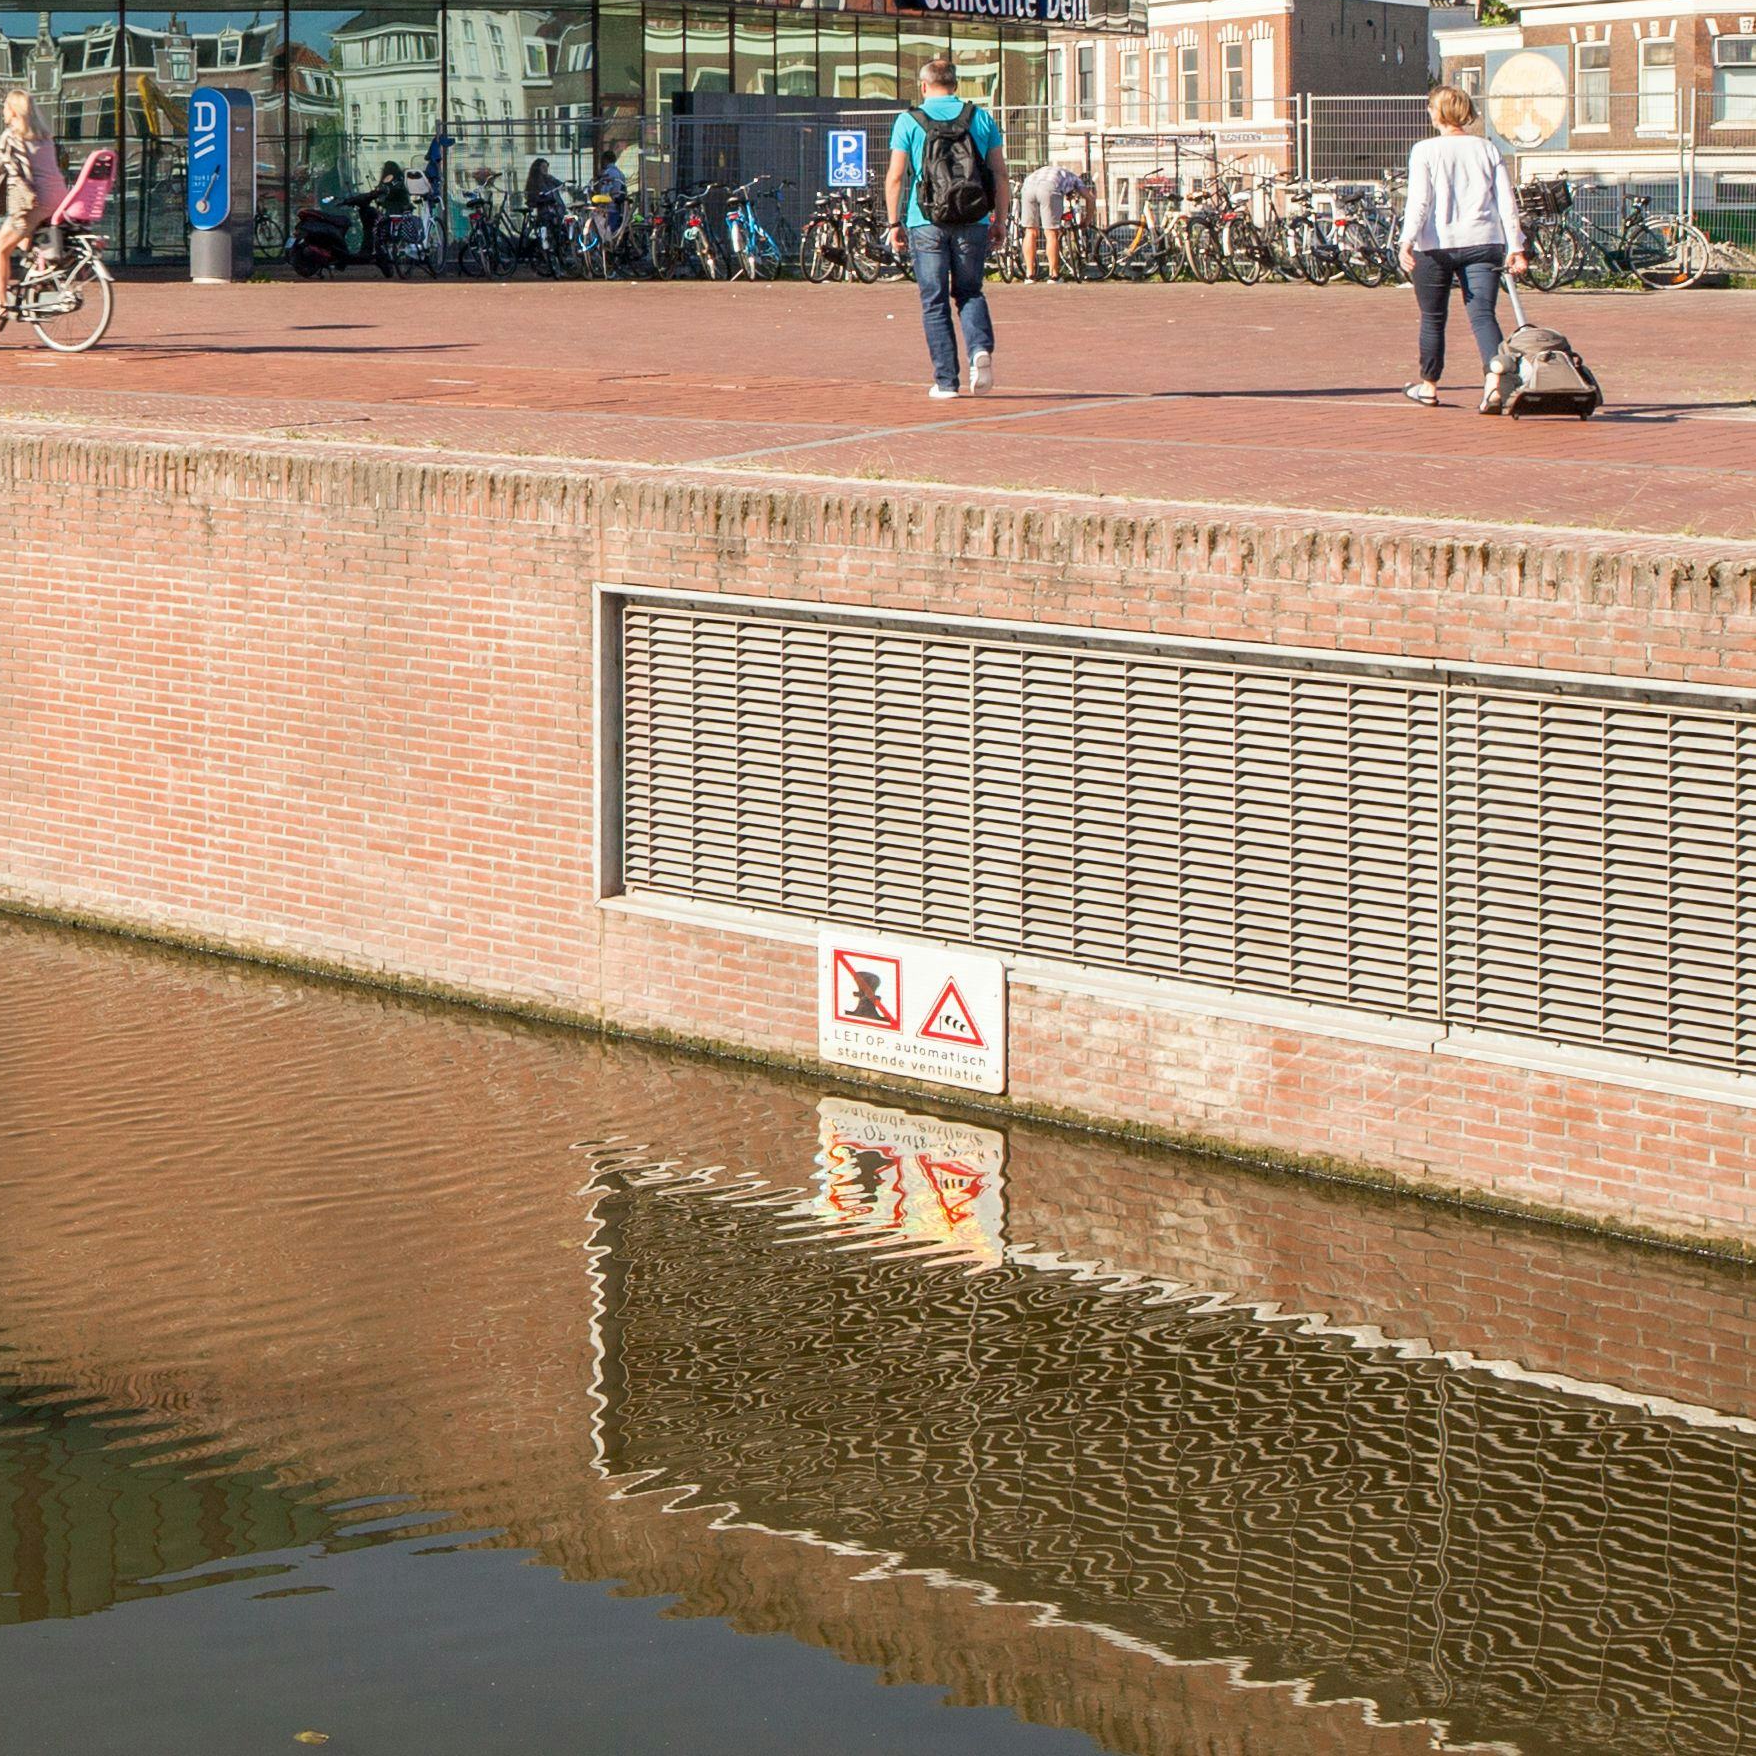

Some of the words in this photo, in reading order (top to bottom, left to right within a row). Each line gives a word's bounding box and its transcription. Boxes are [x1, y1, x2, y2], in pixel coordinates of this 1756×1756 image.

[837, 135, 858, 163] P
[834, 1028, 859, 1043] LET
[895, 1042, 986, 1067] automatisch
[838, 1047, 905, 1067] startende
[911, 1061, 982, 1082] ventilatie
